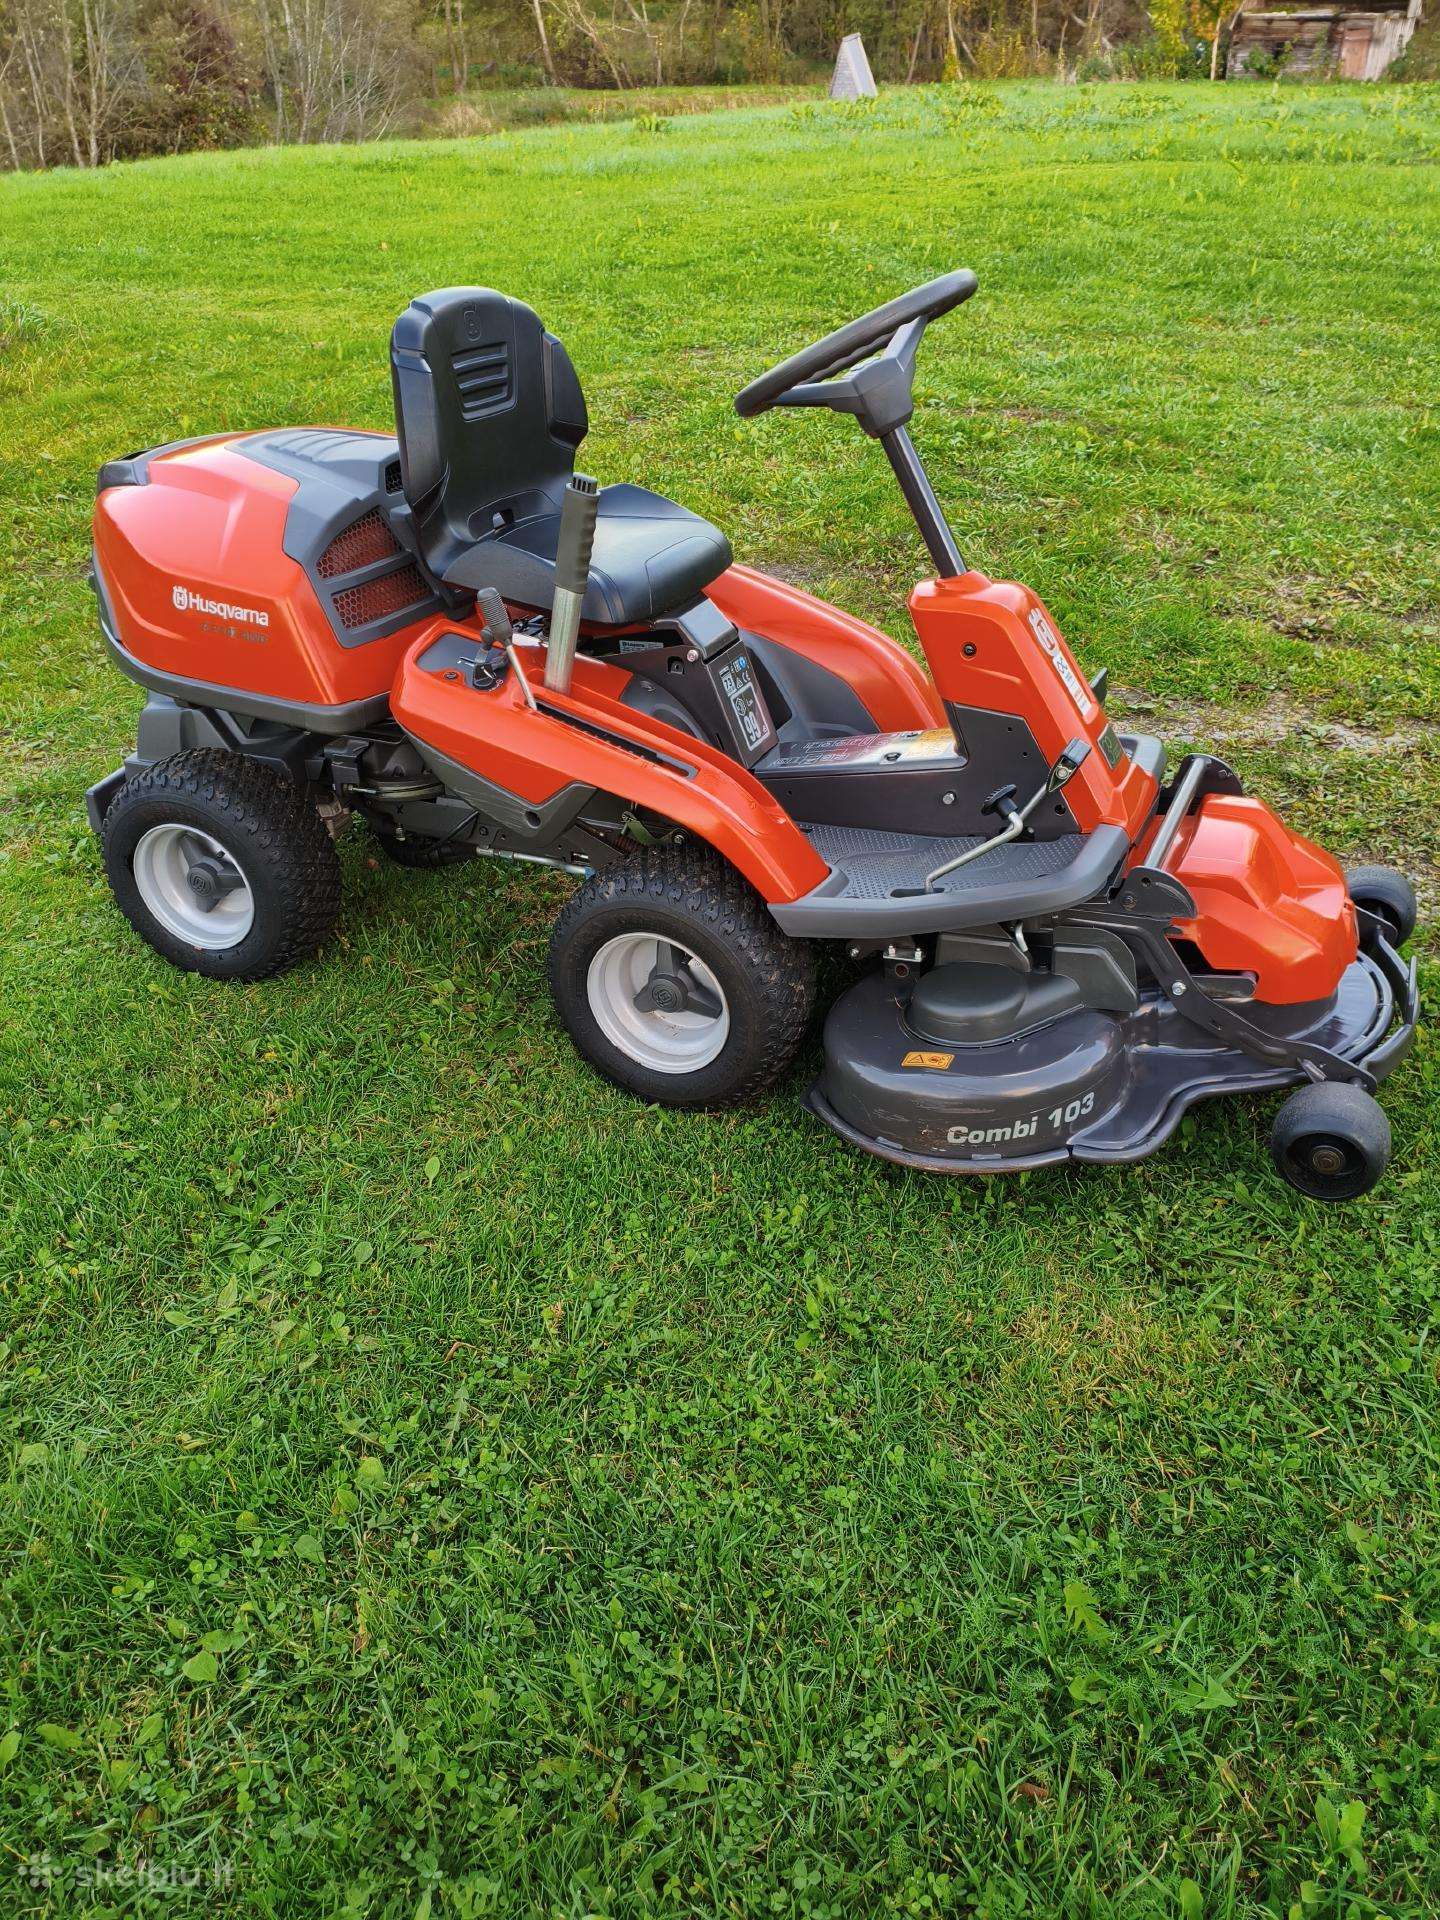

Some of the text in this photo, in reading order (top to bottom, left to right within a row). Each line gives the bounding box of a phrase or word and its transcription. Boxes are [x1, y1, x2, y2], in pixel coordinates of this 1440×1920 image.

[188, 591, 269, 627] Husqvarna
[743, 711, 762, 742] 99
[946, 1091, 1095, 1144] Combi 103
